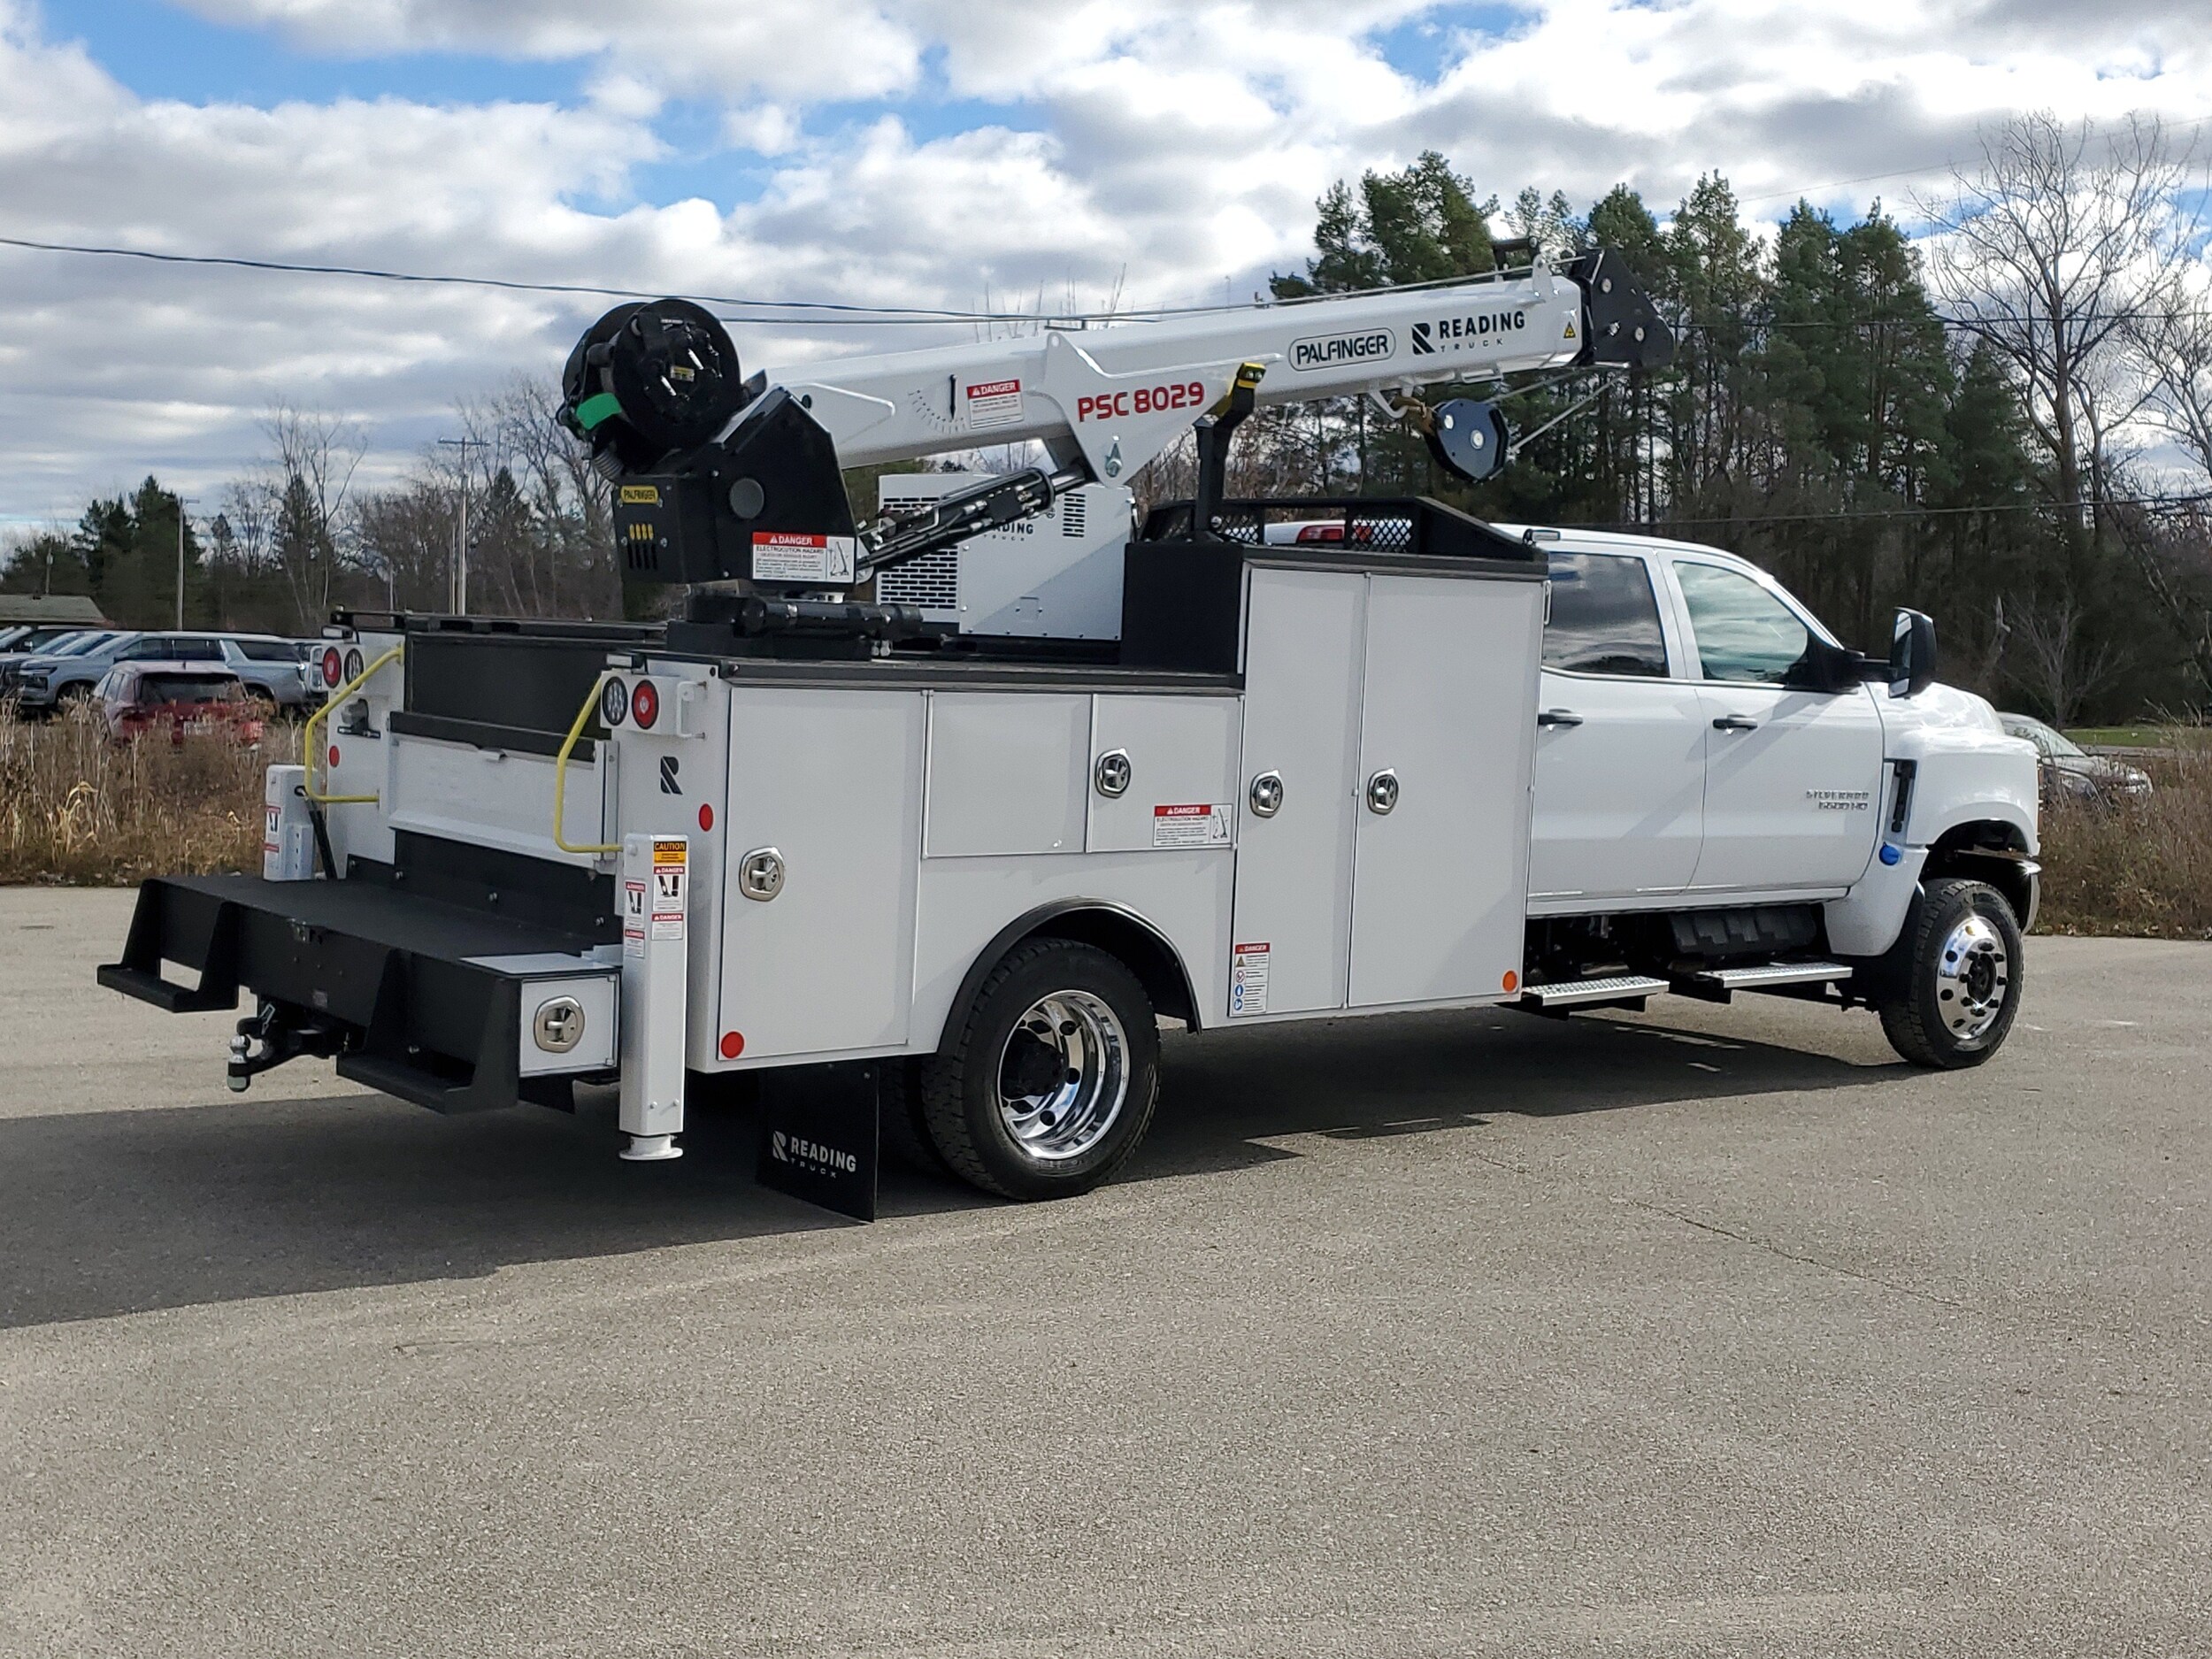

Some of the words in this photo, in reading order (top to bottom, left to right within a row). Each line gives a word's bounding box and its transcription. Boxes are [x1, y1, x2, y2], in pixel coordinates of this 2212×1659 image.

[1439, 311, 1525, 339] READING
[1295, 334, 1389, 365] PALFINGER
[1440, 337, 1503, 352] TRUCK
[981, 381, 1016, 395] DANGER
[1078, 391, 1129, 423] PSC
[1134, 381, 1205, 413] 8029
[778, 535, 813, 545] DANGER
[791, 1136, 856, 1172] READING
[790, 1157, 836, 1179] TRUCK
